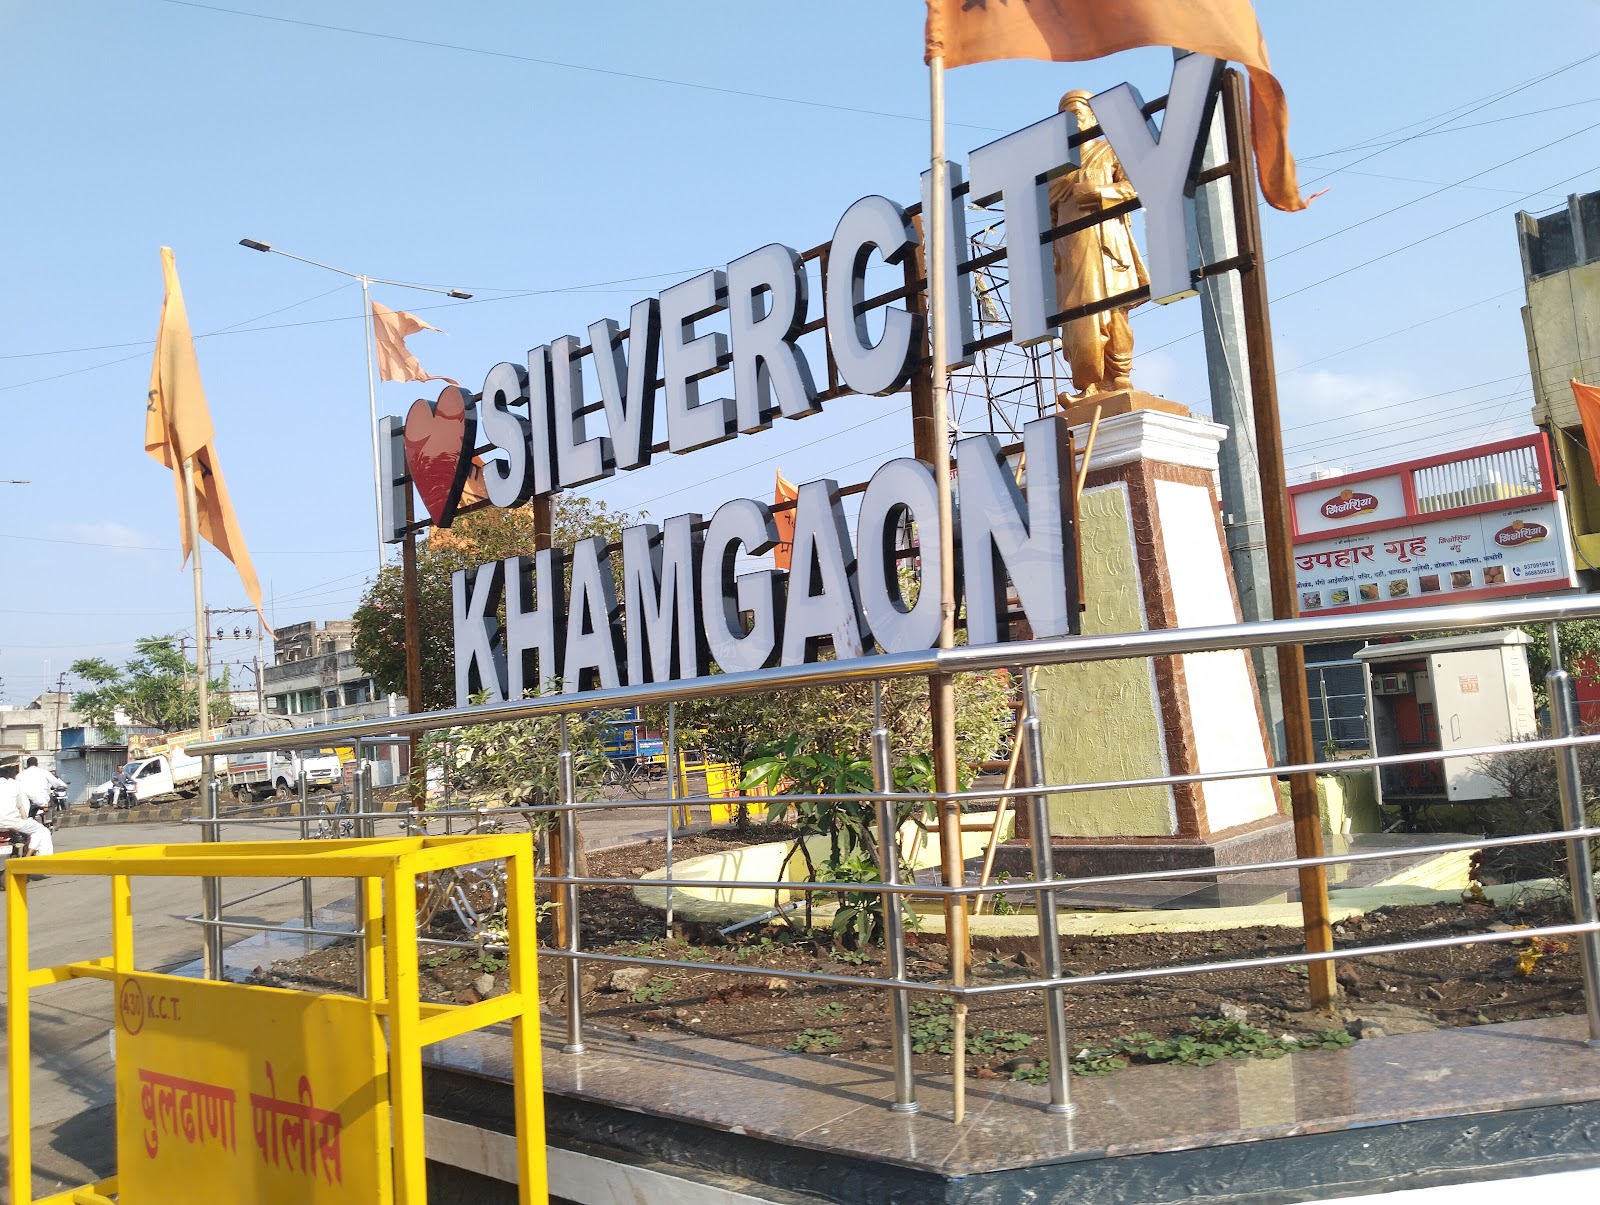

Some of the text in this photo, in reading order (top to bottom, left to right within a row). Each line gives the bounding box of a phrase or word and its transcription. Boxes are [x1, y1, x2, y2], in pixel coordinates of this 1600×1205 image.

[451, 418, 1082, 708] KHAMGAON
[1294, 535, 1427, 571] उपहार गृह
[248, 1059, 343, 1187] पोलीस
